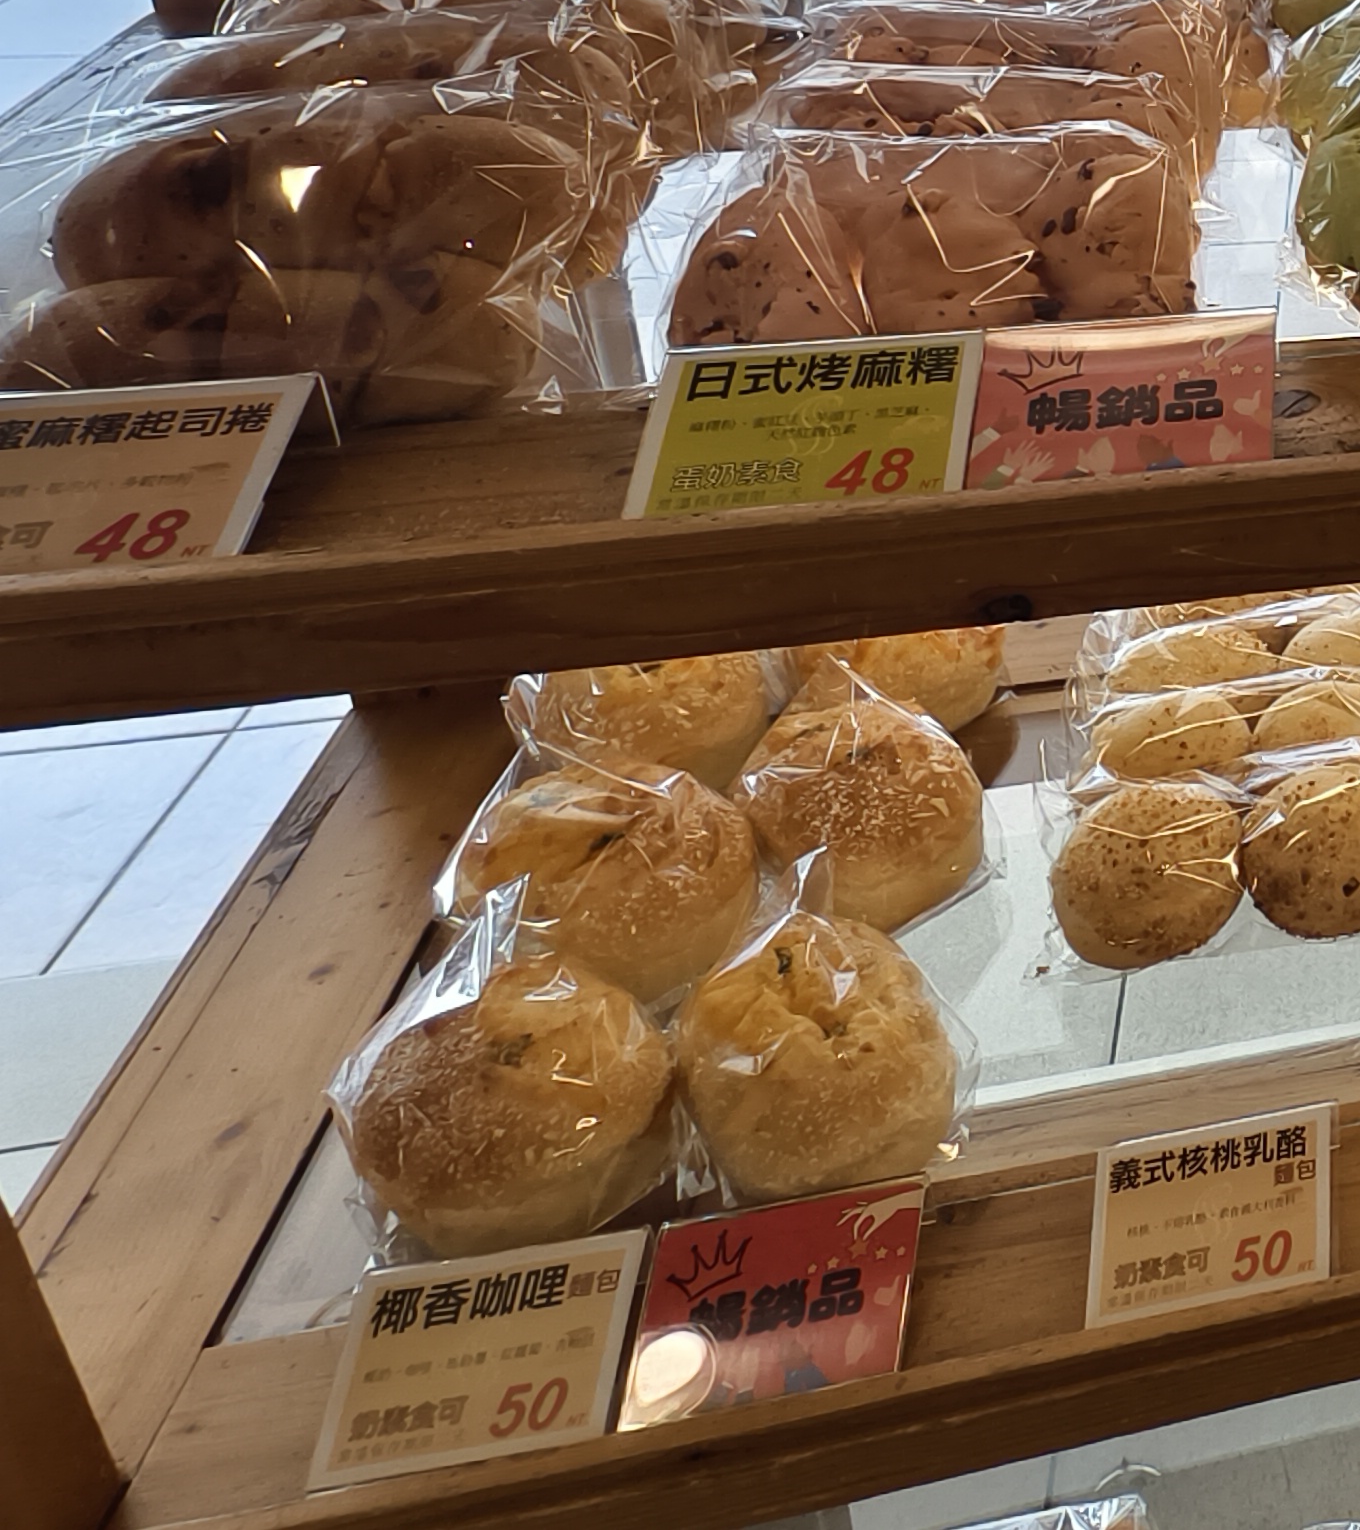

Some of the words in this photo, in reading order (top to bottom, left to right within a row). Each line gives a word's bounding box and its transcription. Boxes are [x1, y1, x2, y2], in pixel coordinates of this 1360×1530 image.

[686, 345, 960, 402] 日式烤麻糬
[1026, 379, 1224, 435] 暢銷品
[671, 456, 804, 494] 蛋奶素食
[825, 447, 915, 497] 48
[918, 478, 943, 491] NT
[73, 508, 191, 563] 48
[180, 544, 212, 559] NT
[1109, 1126, 1307, 1194] 義式核桃乳酪
[1231, 1229, 1293, 1283] 50
[489, 1377, 569, 1439] 50
